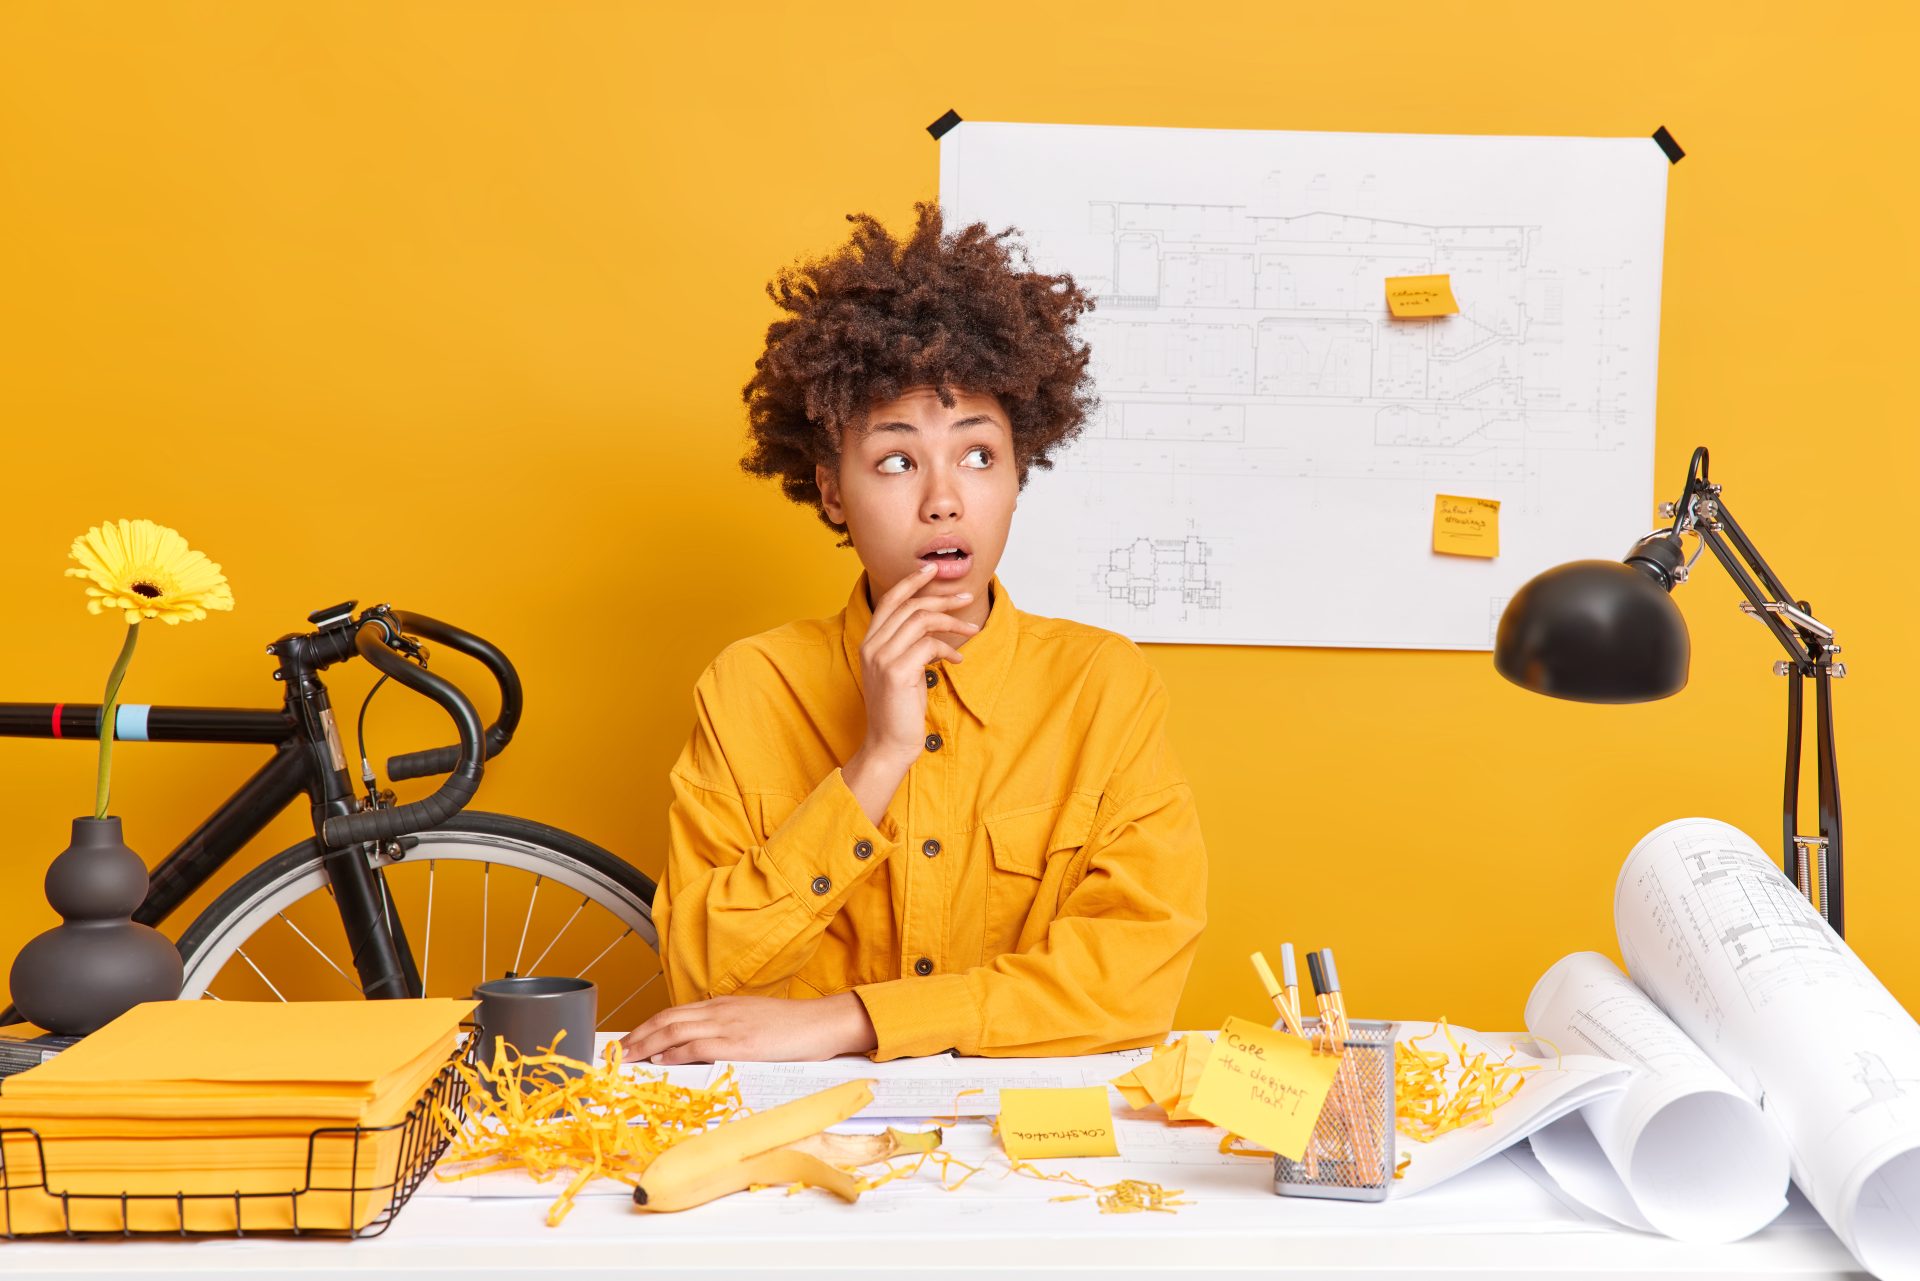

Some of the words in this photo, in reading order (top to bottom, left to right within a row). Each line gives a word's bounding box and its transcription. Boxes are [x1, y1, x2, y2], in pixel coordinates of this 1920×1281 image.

[1227, 1033, 1267, 1061] Call
[1218, 1056, 1243, 1074] the
[1250, 1067, 1309, 1099] designer
